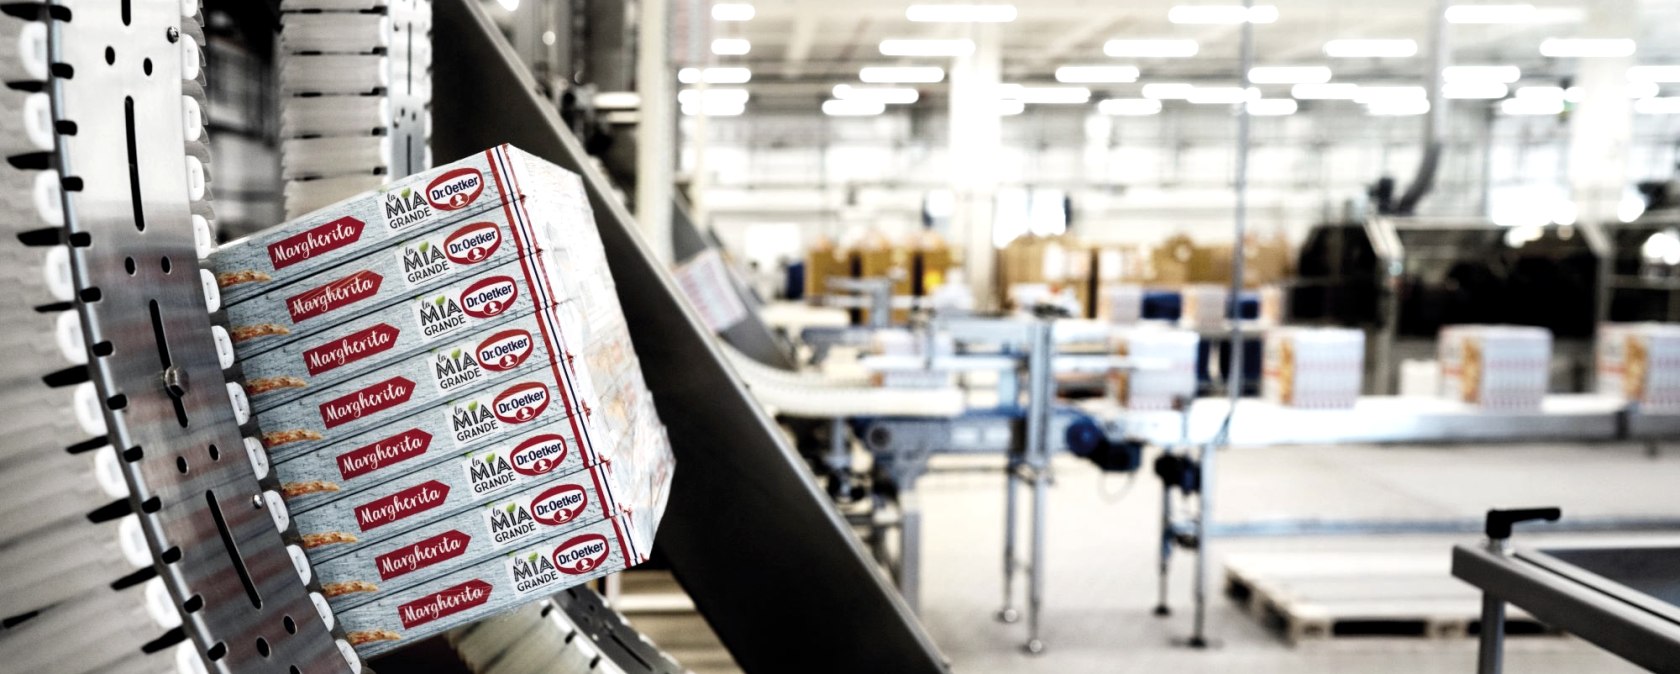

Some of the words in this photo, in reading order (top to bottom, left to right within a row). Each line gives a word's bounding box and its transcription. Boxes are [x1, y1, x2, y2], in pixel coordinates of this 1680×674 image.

[385, 190, 428, 219] MIA
[387, 193, 396, 202] la
[390, 207, 432, 229] GRANDE
[274, 223, 355, 263] Margherita
[405, 247, 414, 256] la
[403, 244, 446, 273] MIA
[408, 261, 450, 283] GRANDE
[292, 276, 373, 316] Margherita
[421, 300, 430, 309] la
[419, 297, 462, 326] MIA
[424, 314, 465, 336] GRANDE
[309, 330, 390, 369] Margherita
[437, 353, 446, 362] la
[435, 350, 478, 379] MIA
[440, 367, 481, 389] GRANDE
[325, 383, 406, 422] Margherita
[454, 405, 463, 414] la
[452, 403, 494, 431] MIA
[457, 420, 498, 441] GRANDE
[343, 435, 422, 474] Margherita
[472, 457, 481, 466] la
[470, 455, 512, 483] MIA
[475, 472, 516, 493] GRANDE
[361, 487, 440, 525] Margherita
[493, 507, 502, 516] la
[491, 505, 533, 533] MIA
[496, 522, 536, 543] GRANDE
[382, 536, 461, 574] Margherita
[515, 556, 524, 565] la
[513, 554, 555, 582] MIA
[518, 571, 558, 592] GRANDE
[404, 585, 483, 623] Margherita
